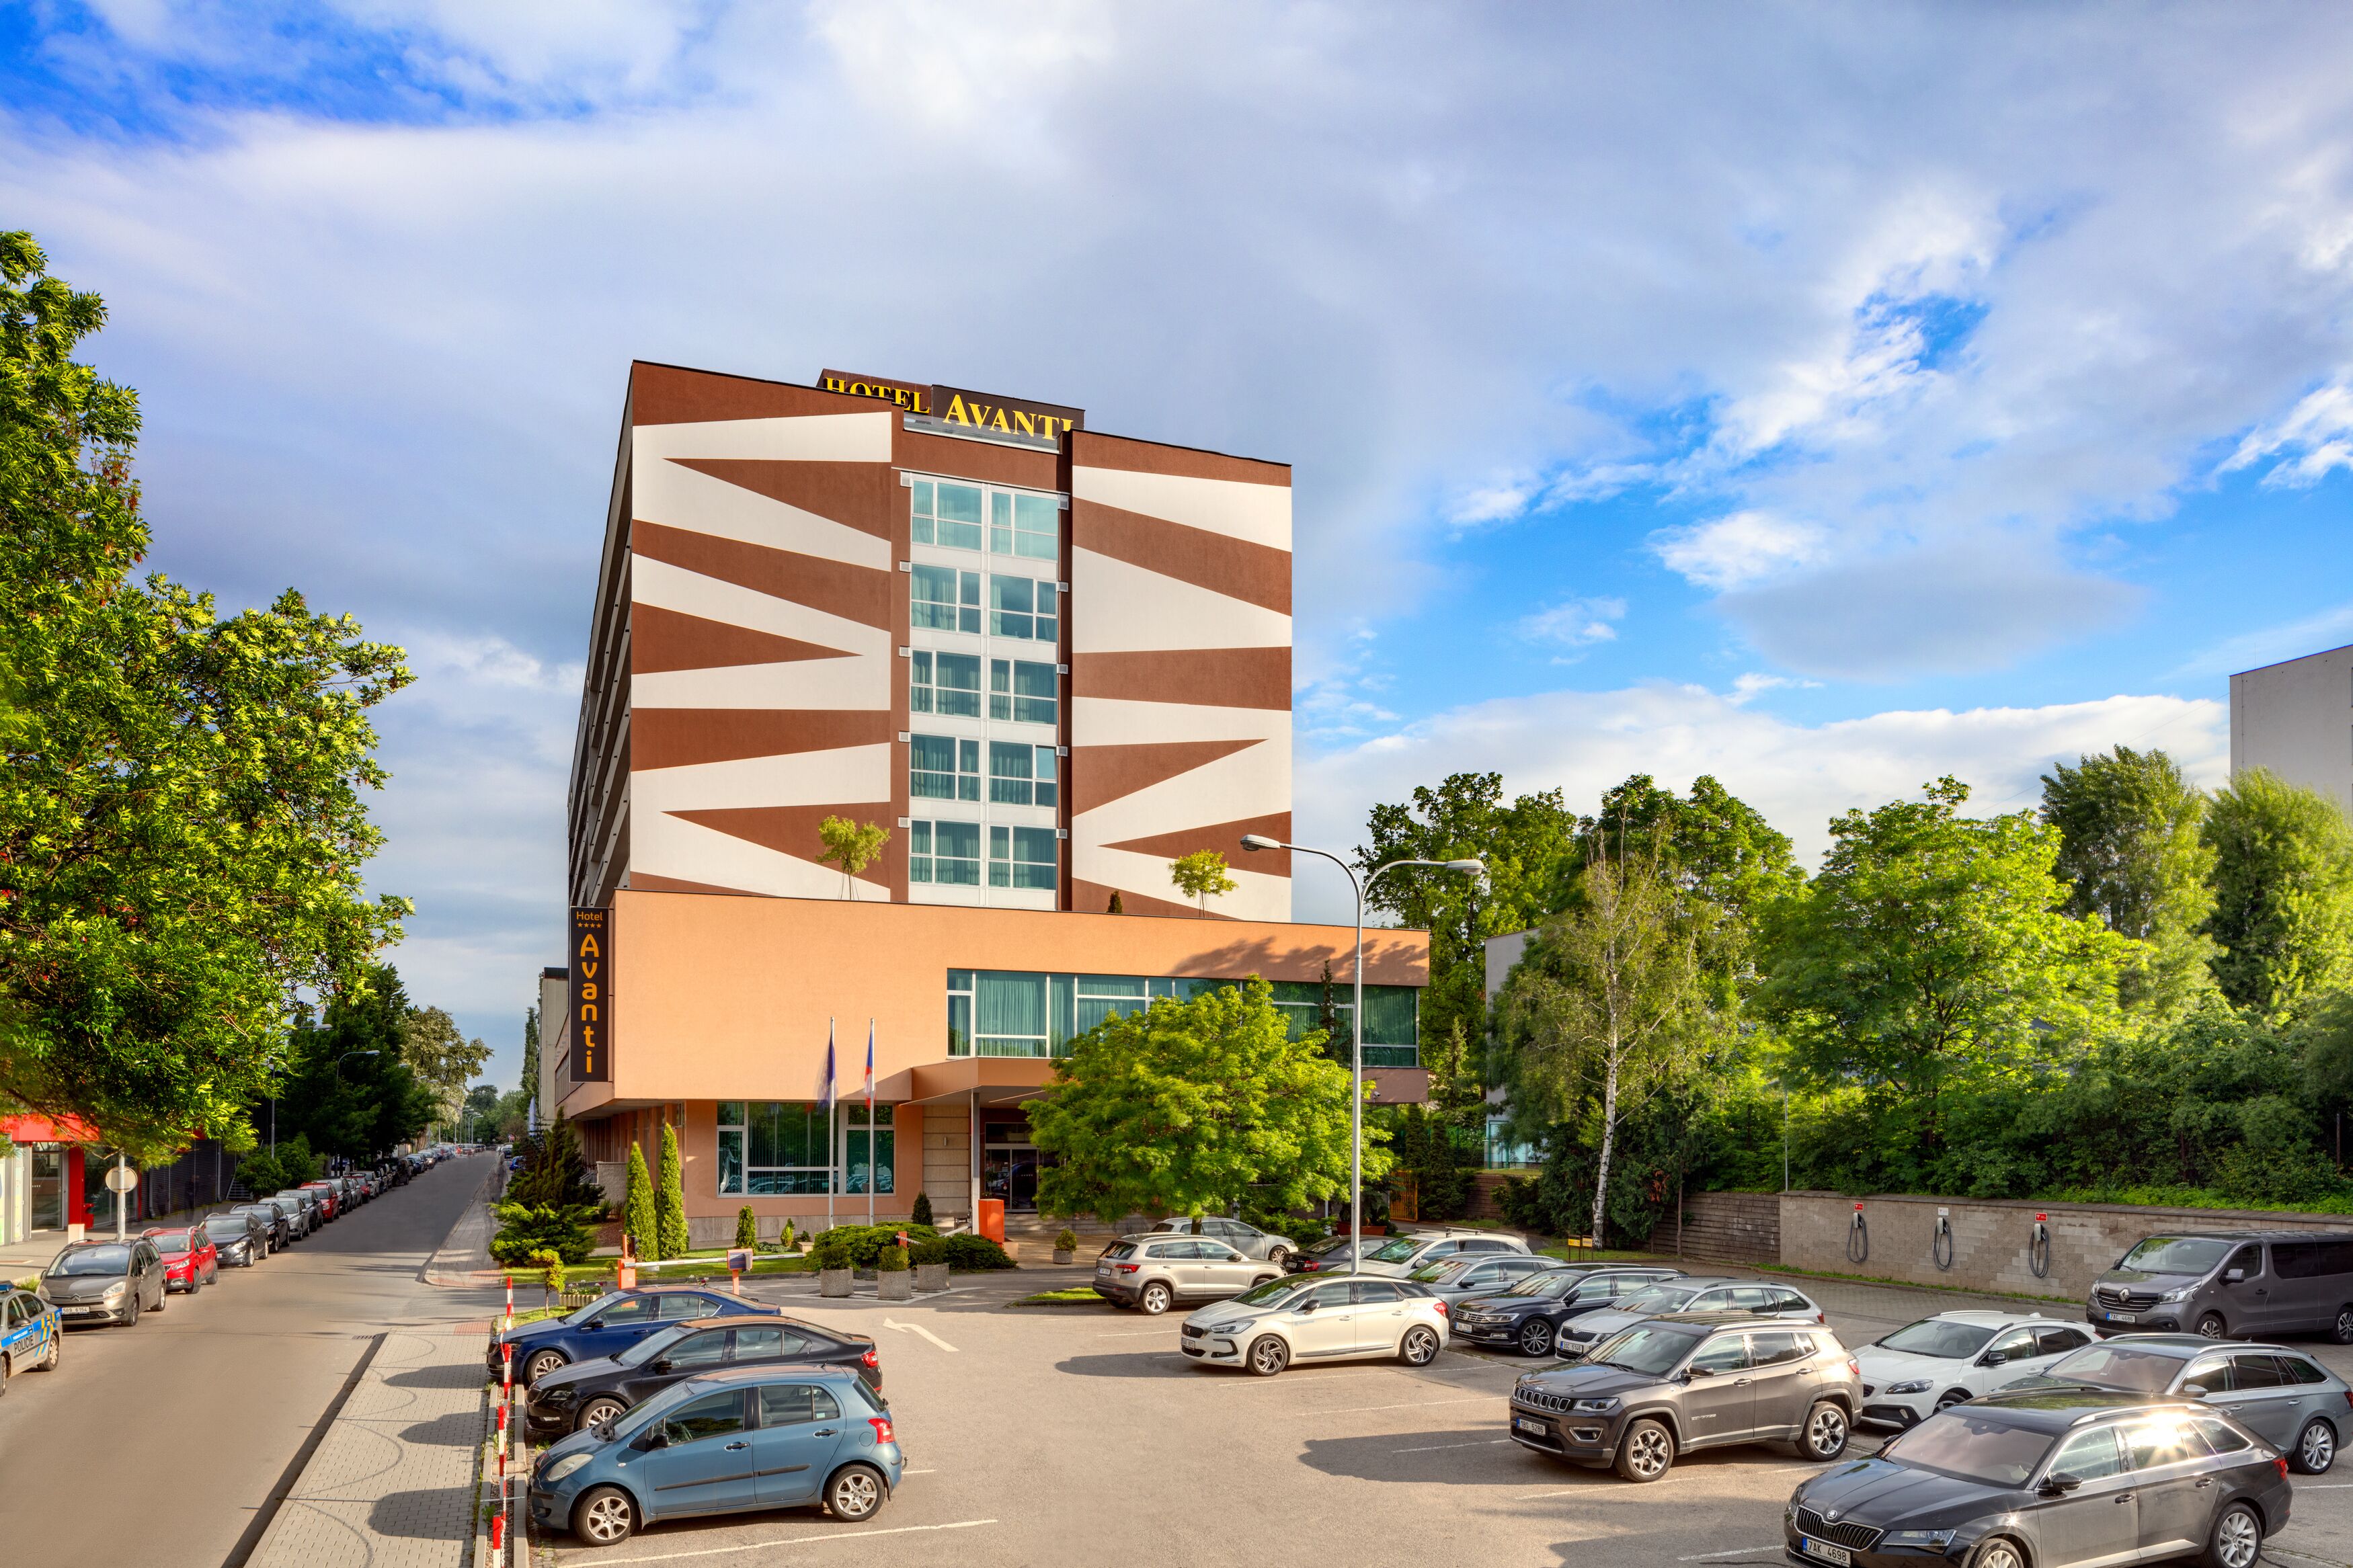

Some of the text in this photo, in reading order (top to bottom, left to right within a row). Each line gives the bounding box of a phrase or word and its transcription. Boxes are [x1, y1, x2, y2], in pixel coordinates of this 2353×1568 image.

[824, 374, 930, 414] HOTEL
[576, 911, 603, 921] Hotel
[580, 934, 600, 1073] Avanti
[13, 1335, 34, 1354] POLICIE
[1521, 1420, 1529, 1430] 1BS
[1531, 1423, 1544, 1434] 5286
[1808, 1540, 1847, 1561] 7AK 4698
